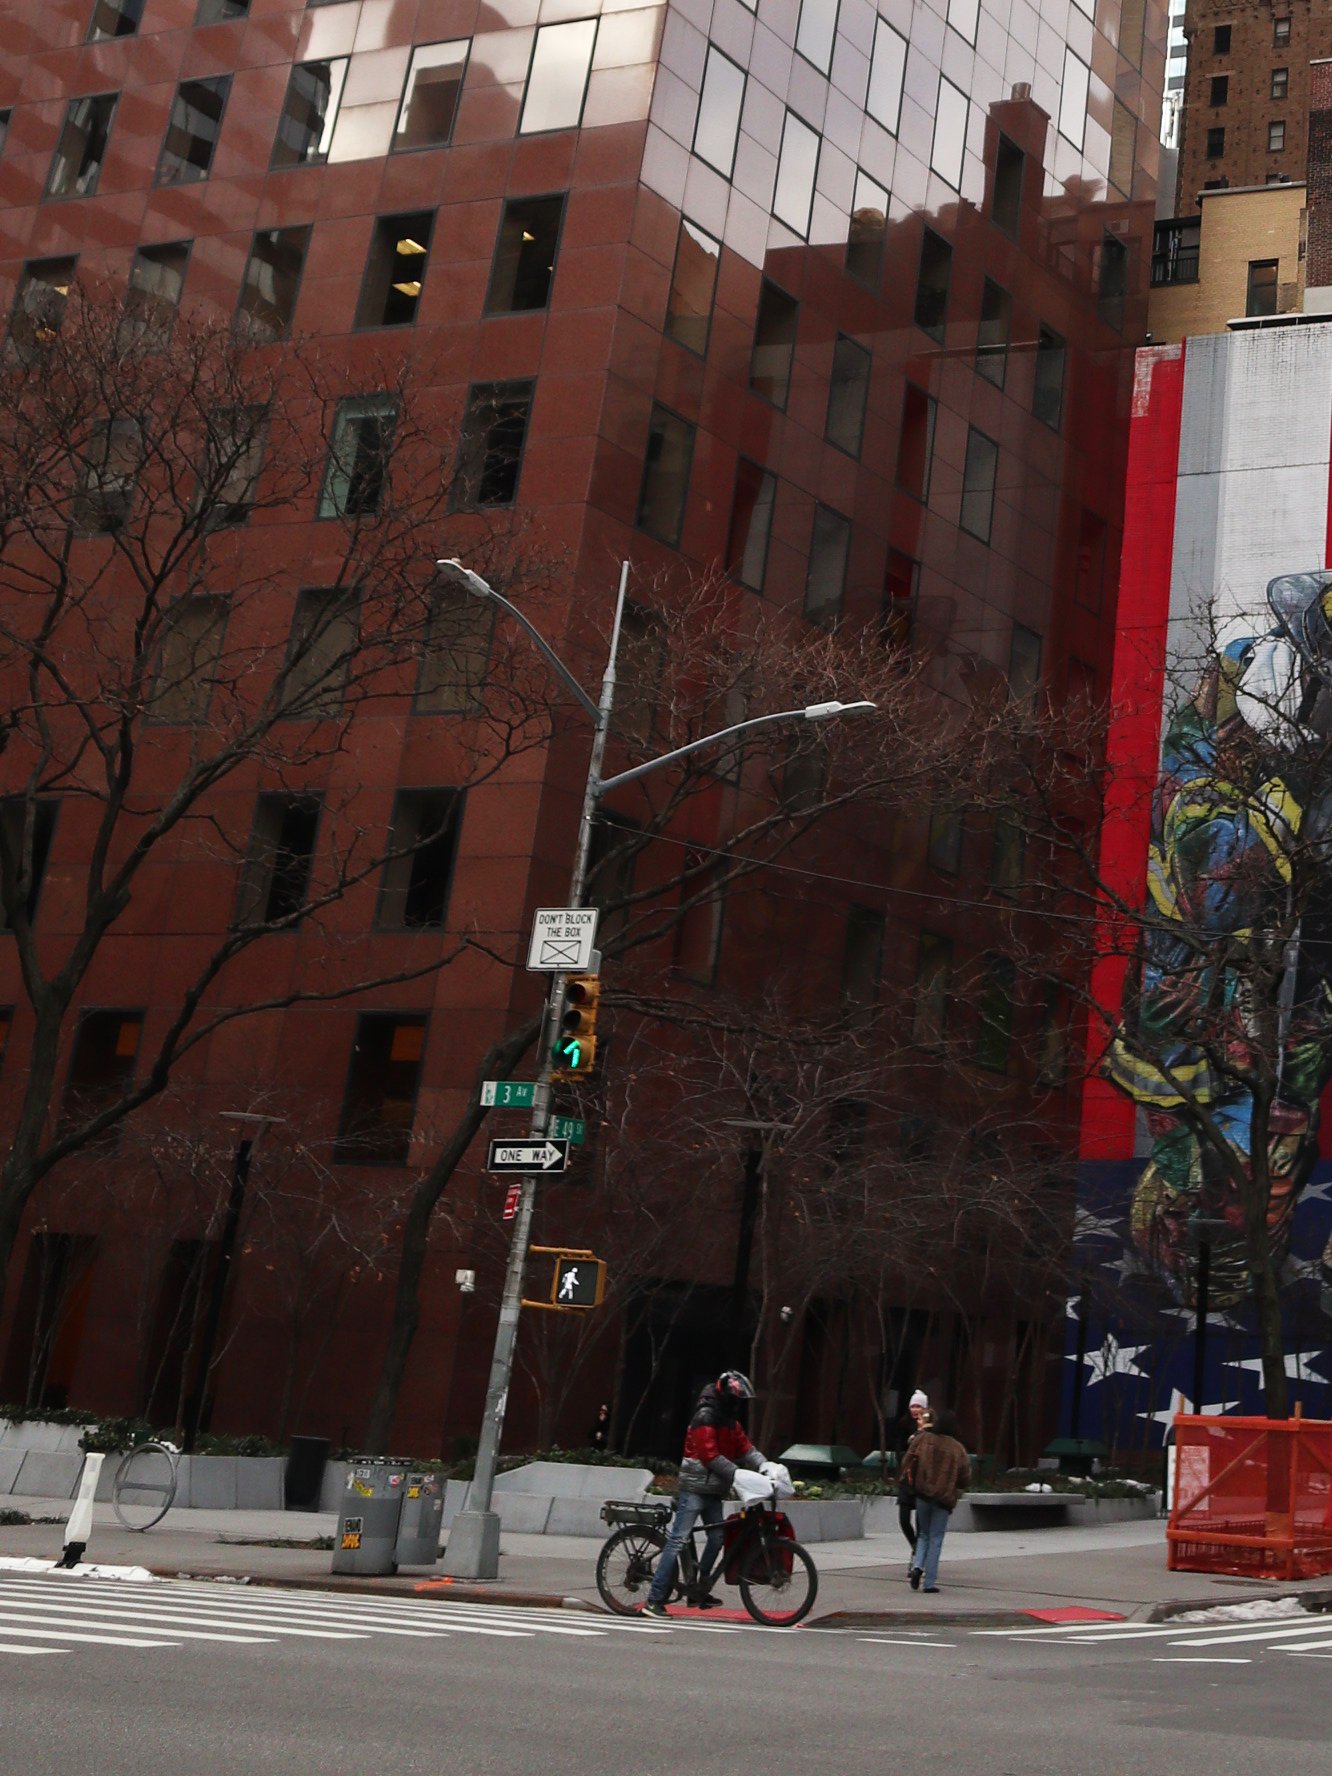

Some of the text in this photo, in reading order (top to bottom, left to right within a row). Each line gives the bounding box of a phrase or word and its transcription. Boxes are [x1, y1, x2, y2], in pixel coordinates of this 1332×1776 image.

[539, 914, 592, 924] DON'T BLOCK
[547, 927, 581, 937] THE BOX
[503, 1085, 511, 1103] 3
[562, 1121, 573, 1139] 49
[501, 1150, 555, 1161] ONE WAY
